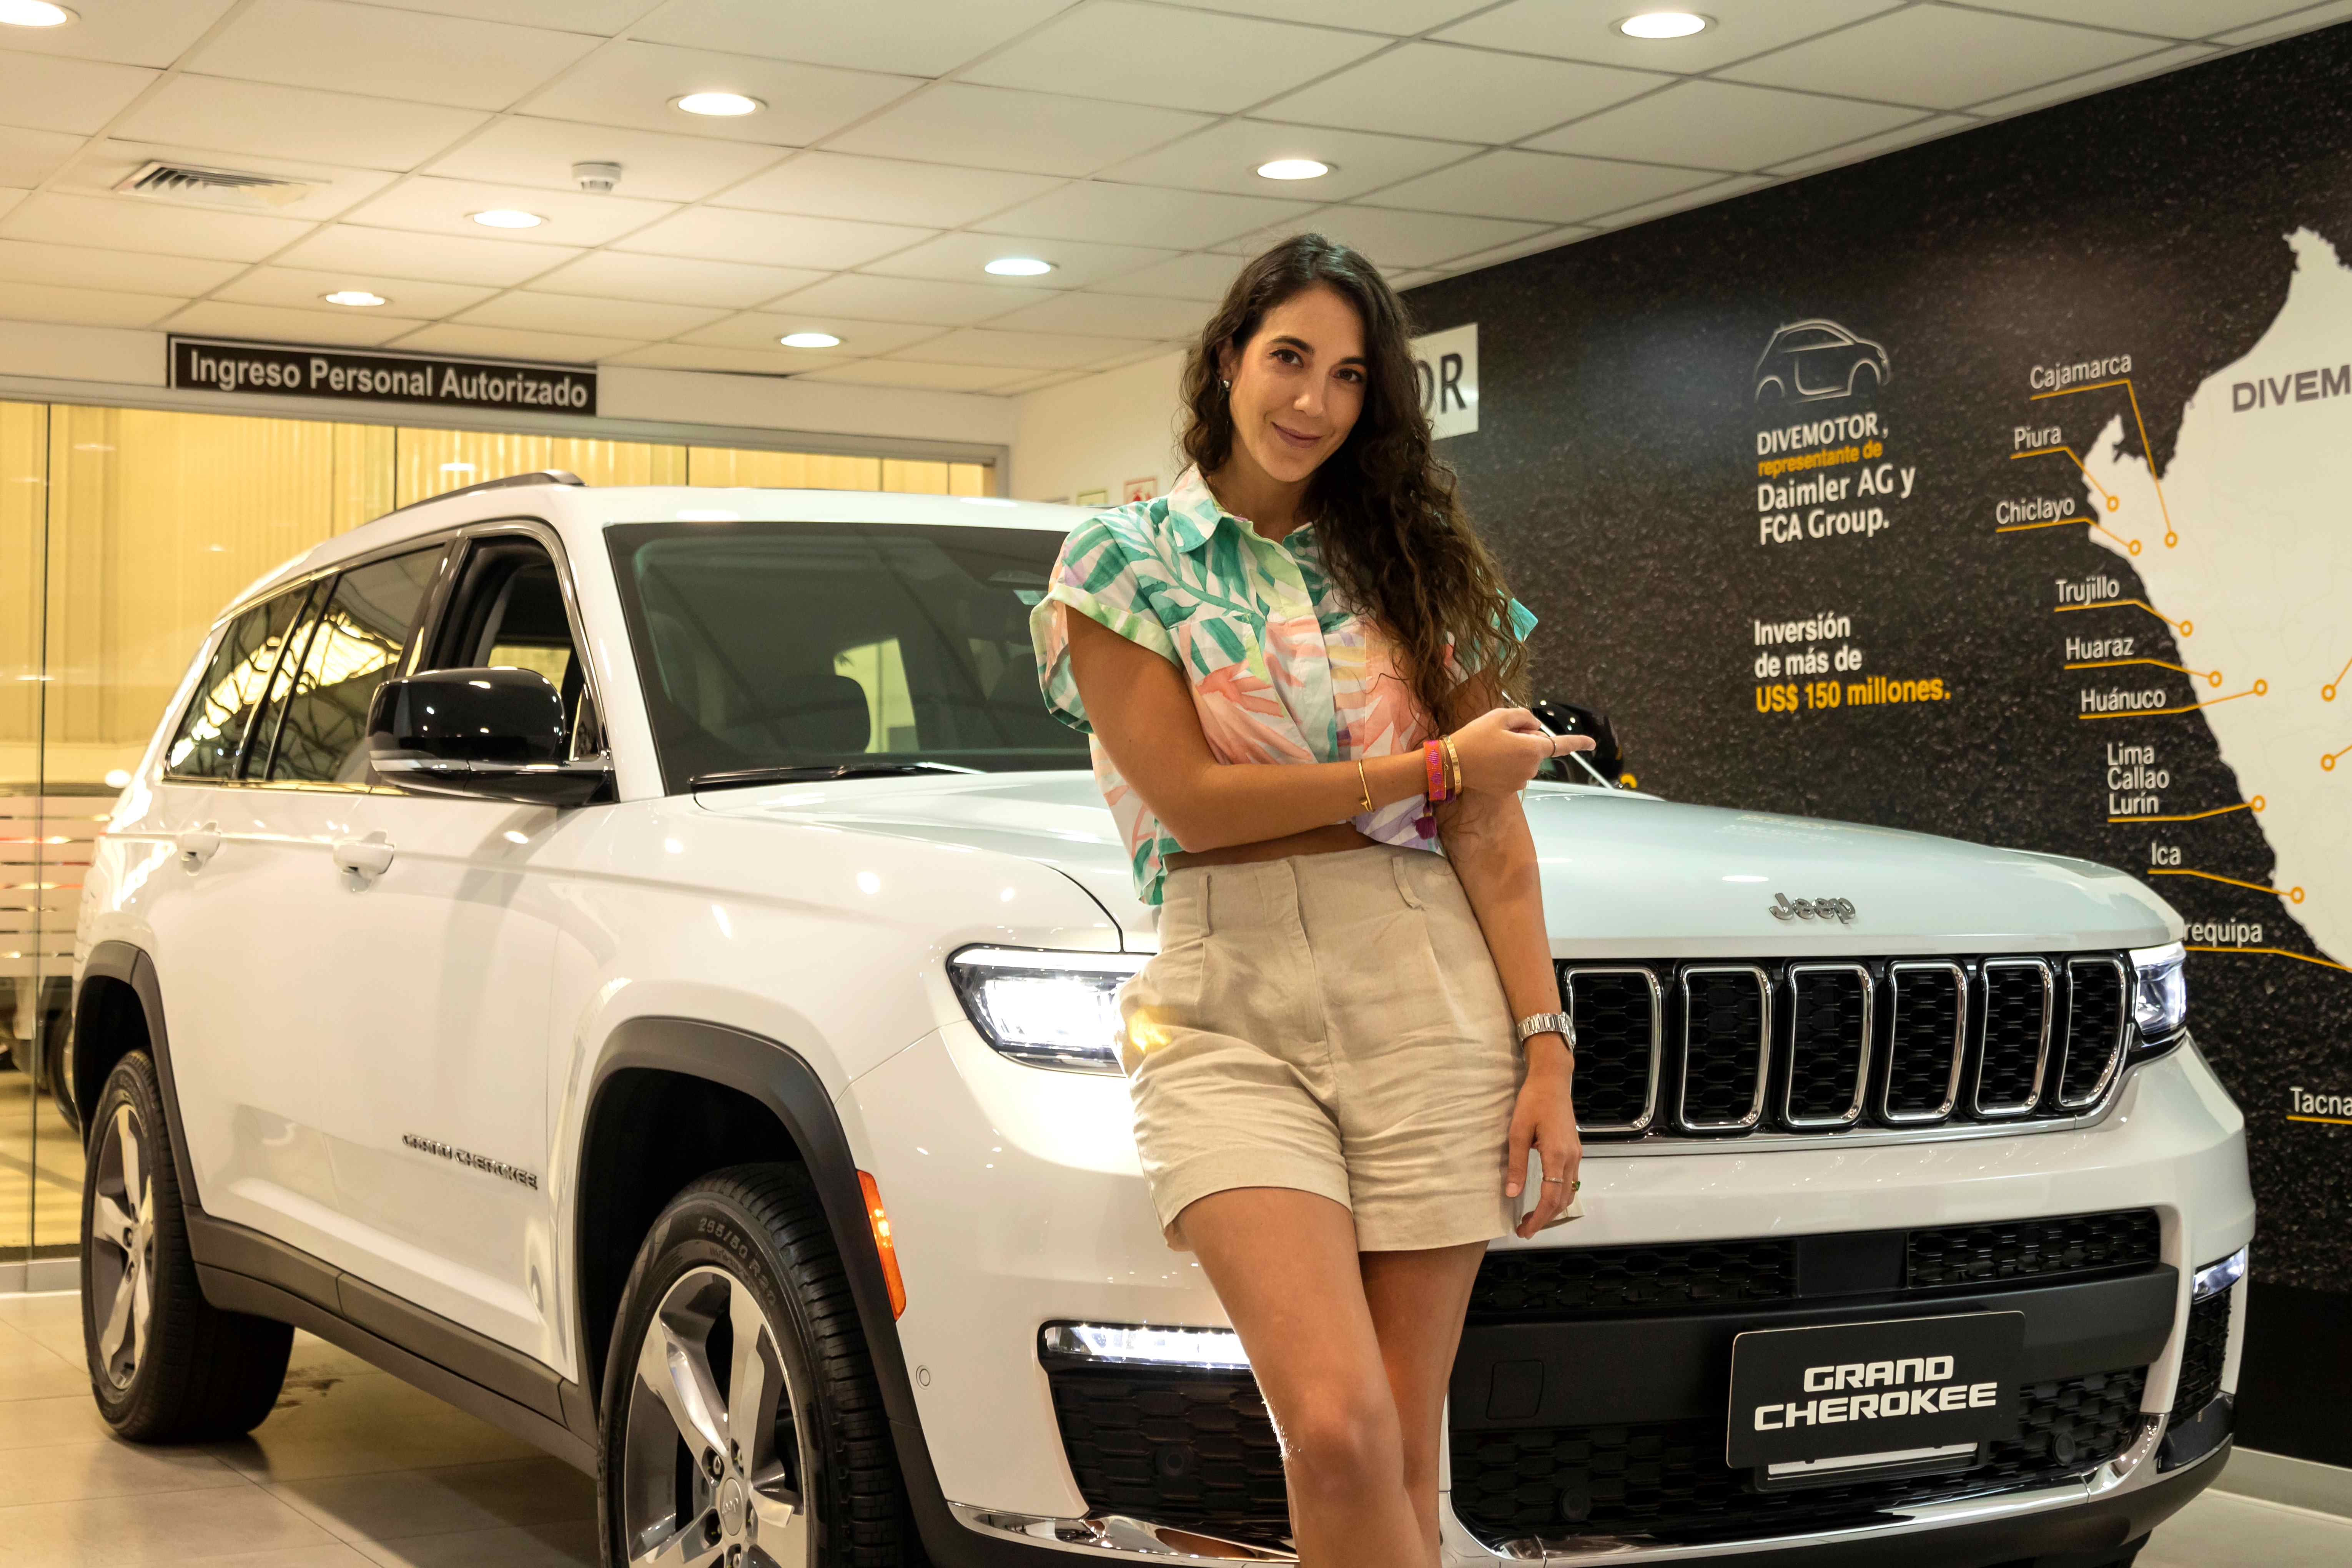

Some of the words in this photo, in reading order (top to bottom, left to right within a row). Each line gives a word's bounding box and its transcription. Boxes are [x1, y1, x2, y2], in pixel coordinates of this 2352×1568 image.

[191, 349, 301, 391] Ingreso
[309, 357, 432, 397] Personal
[440, 366, 588, 408] Autorizado
[2030, 354, 2132, 391] Cajamarca
[2014, 424, 2062, 450] Piura
[1758, 445, 1860, 479] representante
[1862, 439, 1883, 459] de
[1757, 473, 1850, 512] Daimler
[1857, 463, 1894, 497] AG
[1900, 466, 1916, 499] y
[1760, 511, 1803, 545] FCA
[1808, 507, 1890, 538] Group.
[1996, 496, 2075, 524] Chiclayo
[2055, 575, 2120, 606] Trujillo
[1754, 612, 1851, 645] Inversión
[1755, 651, 1781, 678] de
[1785, 646, 1829, 676] más
[1834, 644, 1862, 671] de
[2066, 636, 2134, 661] Huaraz
[1756, 683, 1798, 713] US$
[1805, 680, 1841, 709] 150
[1847, 675, 1951, 706] millones.
[2081, 686, 2166, 712] Huánuco
[2107, 741, 2154, 766] Lima
[2107, 765, 2170, 790] Callao
[2109, 790, 2159, 815] Lurín
[2151, 842, 2182, 866] Ica
[1769, 892, 1856, 924] Jeep
[2184, 916, 2263, 948] requipa
[2289, 1086, 2352, 1116] Tacna
[1804, 1355, 1954, 1393] GRAND
[1754, 1382, 1998, 1431] CHEROKEE
